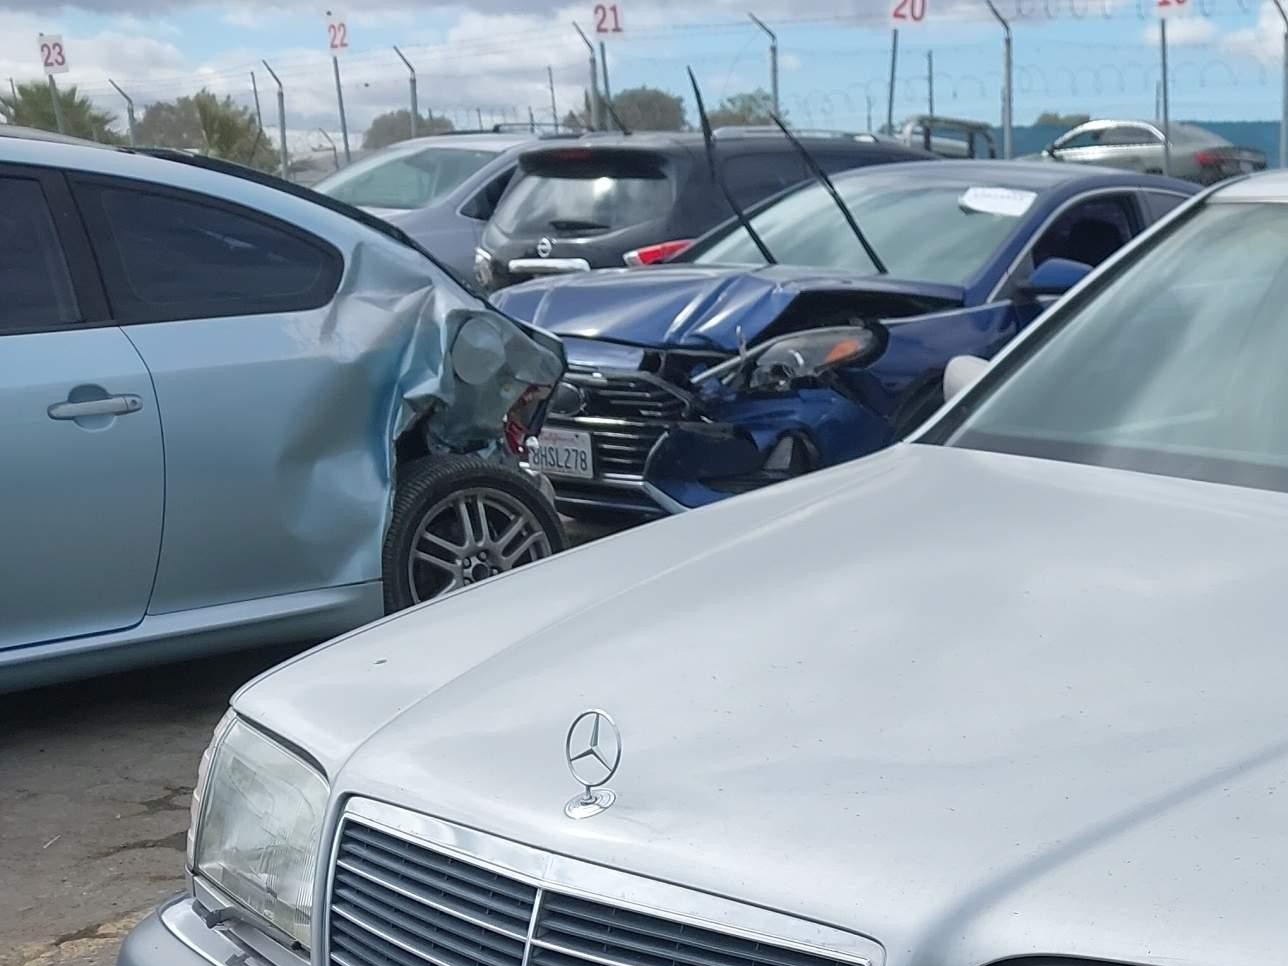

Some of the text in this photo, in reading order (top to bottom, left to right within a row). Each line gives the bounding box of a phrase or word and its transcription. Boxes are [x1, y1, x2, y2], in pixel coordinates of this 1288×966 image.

[594, 4, 622, 33] 21
[328, 22, 348, 48] 22
[41, 43, 66, 67] 23
